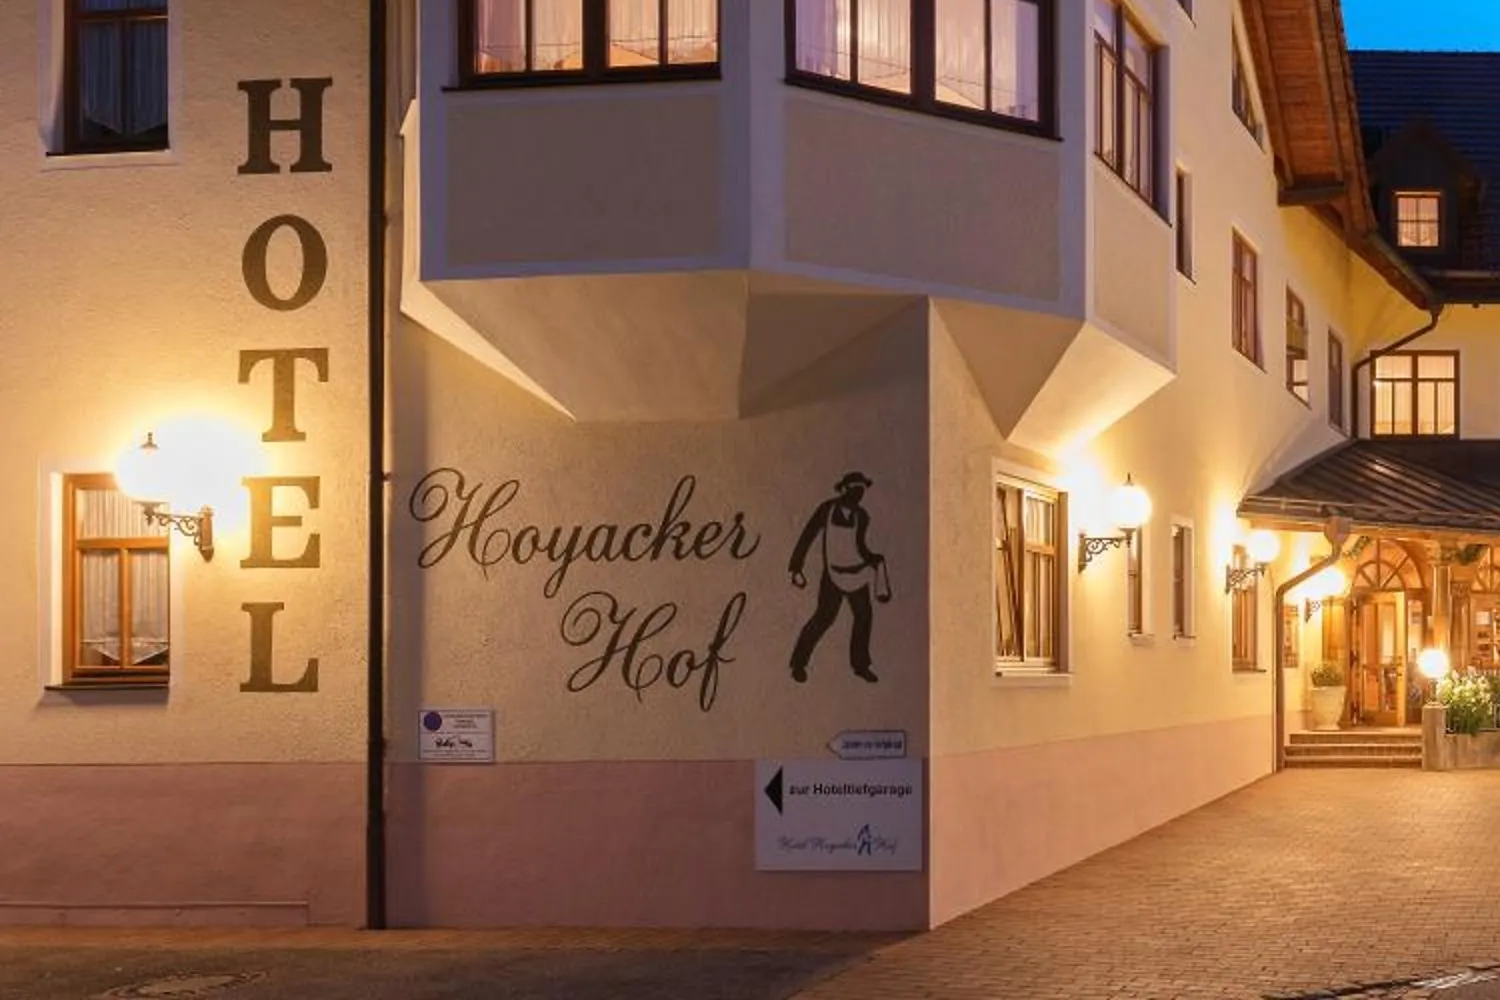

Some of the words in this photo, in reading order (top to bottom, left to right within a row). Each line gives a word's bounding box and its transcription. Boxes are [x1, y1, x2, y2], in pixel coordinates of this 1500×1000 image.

[236, 76, 333, 693] HOTEL
[409, 467, 760, 599] Hoyacker
[560, 591, 747, 712] Hof
[789, 785, 809, 796] zur
[813, 783, 913, 798] Hoteltiefgarage
